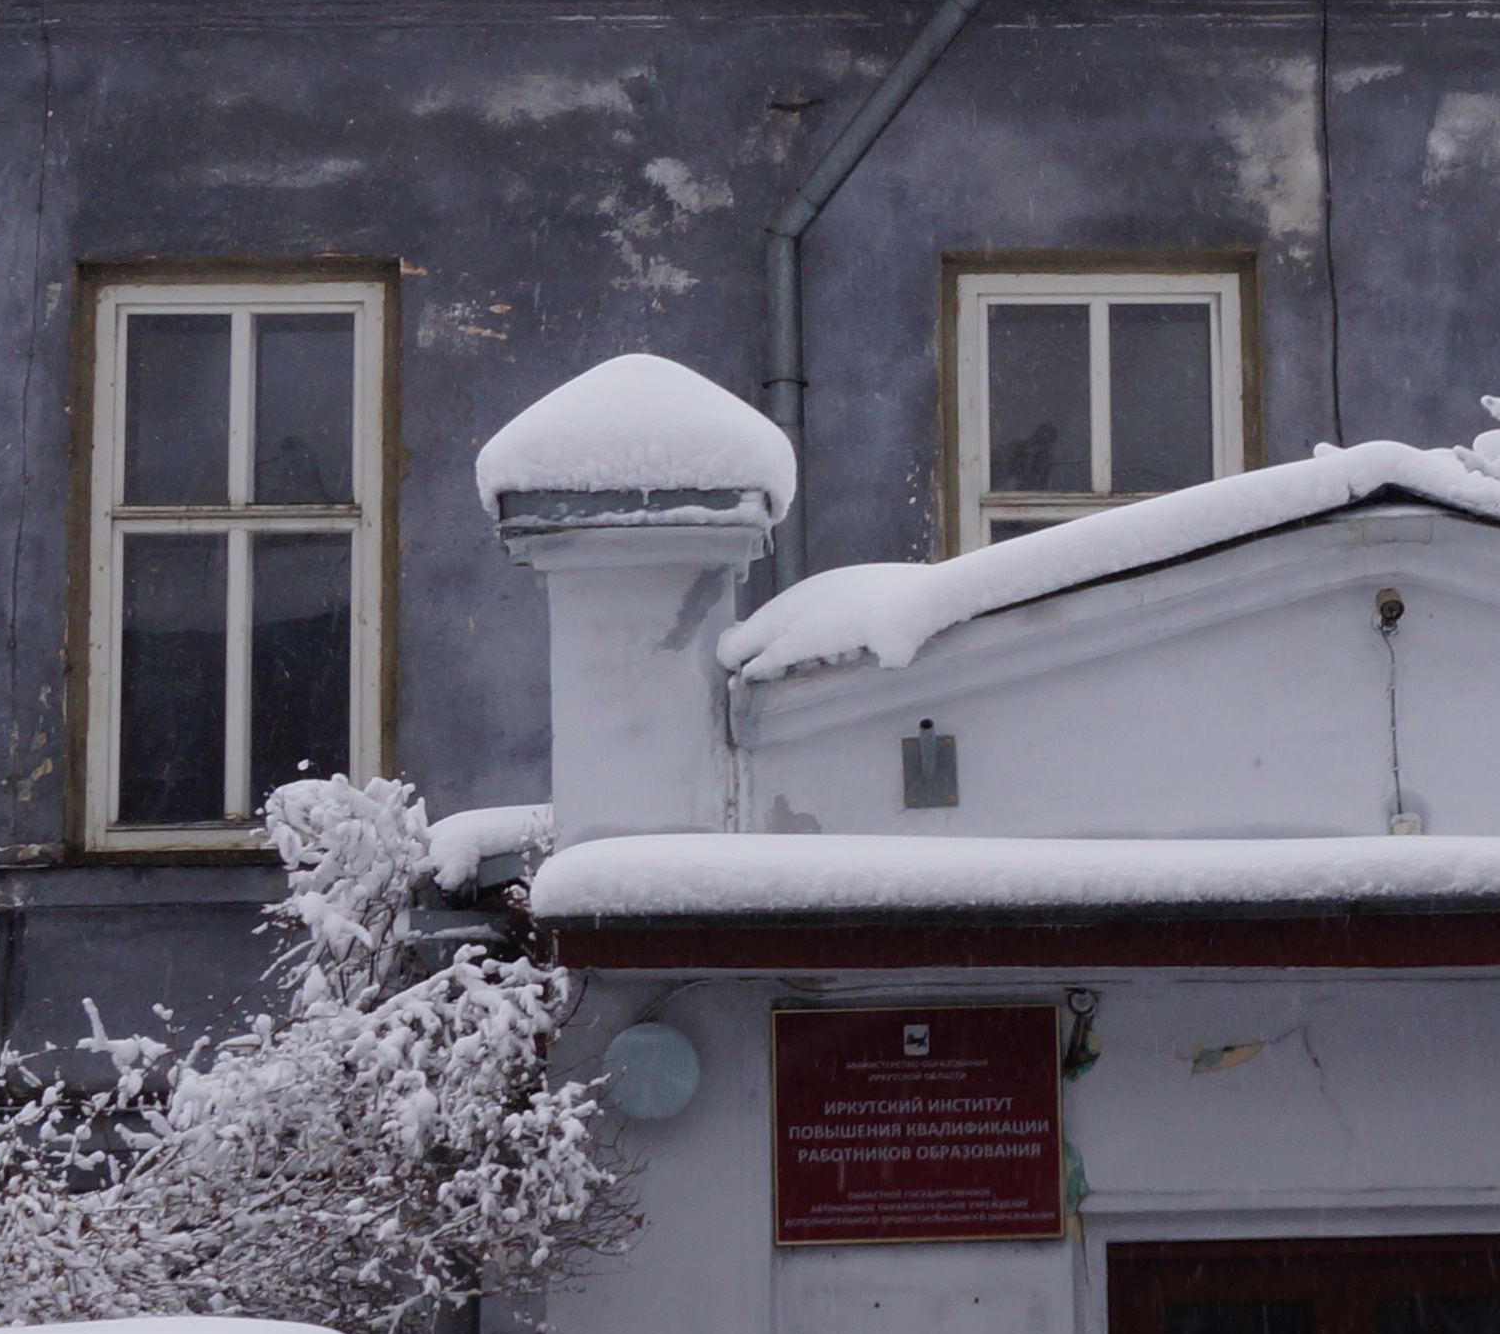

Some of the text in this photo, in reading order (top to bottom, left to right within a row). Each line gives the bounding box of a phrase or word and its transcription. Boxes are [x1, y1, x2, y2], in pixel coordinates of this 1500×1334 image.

[824, 1096, 1013, 1115] ИРКУТСКИЙ ИНСТИТУТ
[788, 1120, 1049, 1140] ПОВЫШЕНИЯ КВАЛИФИКАЦИИ
[797, 1143, 1041, 1163] РАБОТНИКОВ ОБРАЗОВАНИЯ
